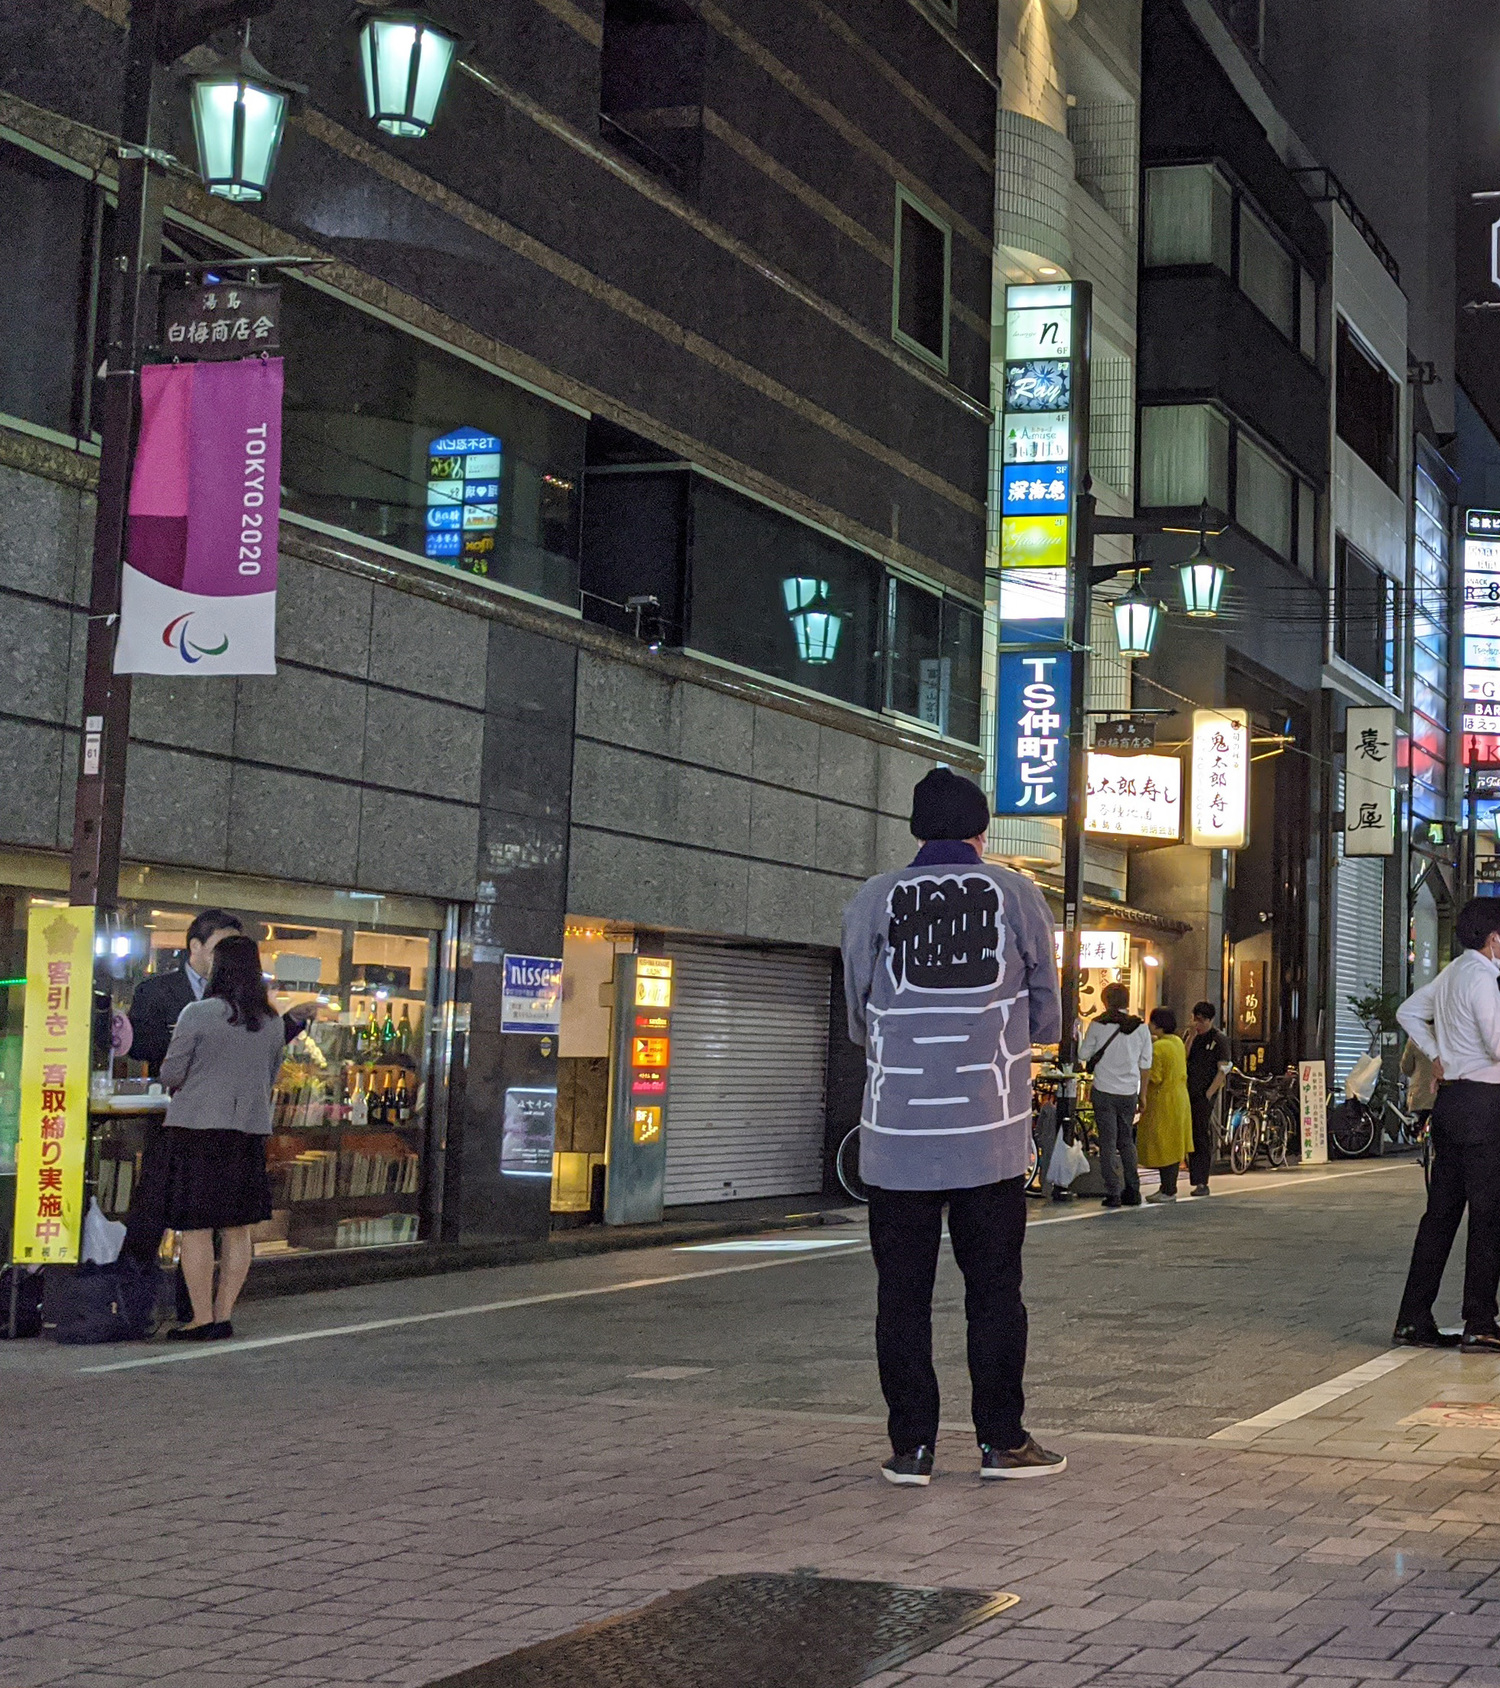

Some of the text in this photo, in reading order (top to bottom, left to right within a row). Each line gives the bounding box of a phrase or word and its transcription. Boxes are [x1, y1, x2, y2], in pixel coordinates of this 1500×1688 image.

[168, 316, 275, 343] 白梅商店会
[1014, 377, 1061, 402] Ray
[1055, 414, 1067, 422] 4F
[1056, 466, 1067, 474] 3F
[238, 422, 268, 576] TOKYO 2020
[1007, 479, 1066, 501] 深海魚
[1015, 657, 1061, 807] TS仲町ビル
[1097, 737, 1153, 748] 白梅商店会
[86, 748, 98, 759] 61
[1208, 731, 1230, 829] 鬼太郎寿し
